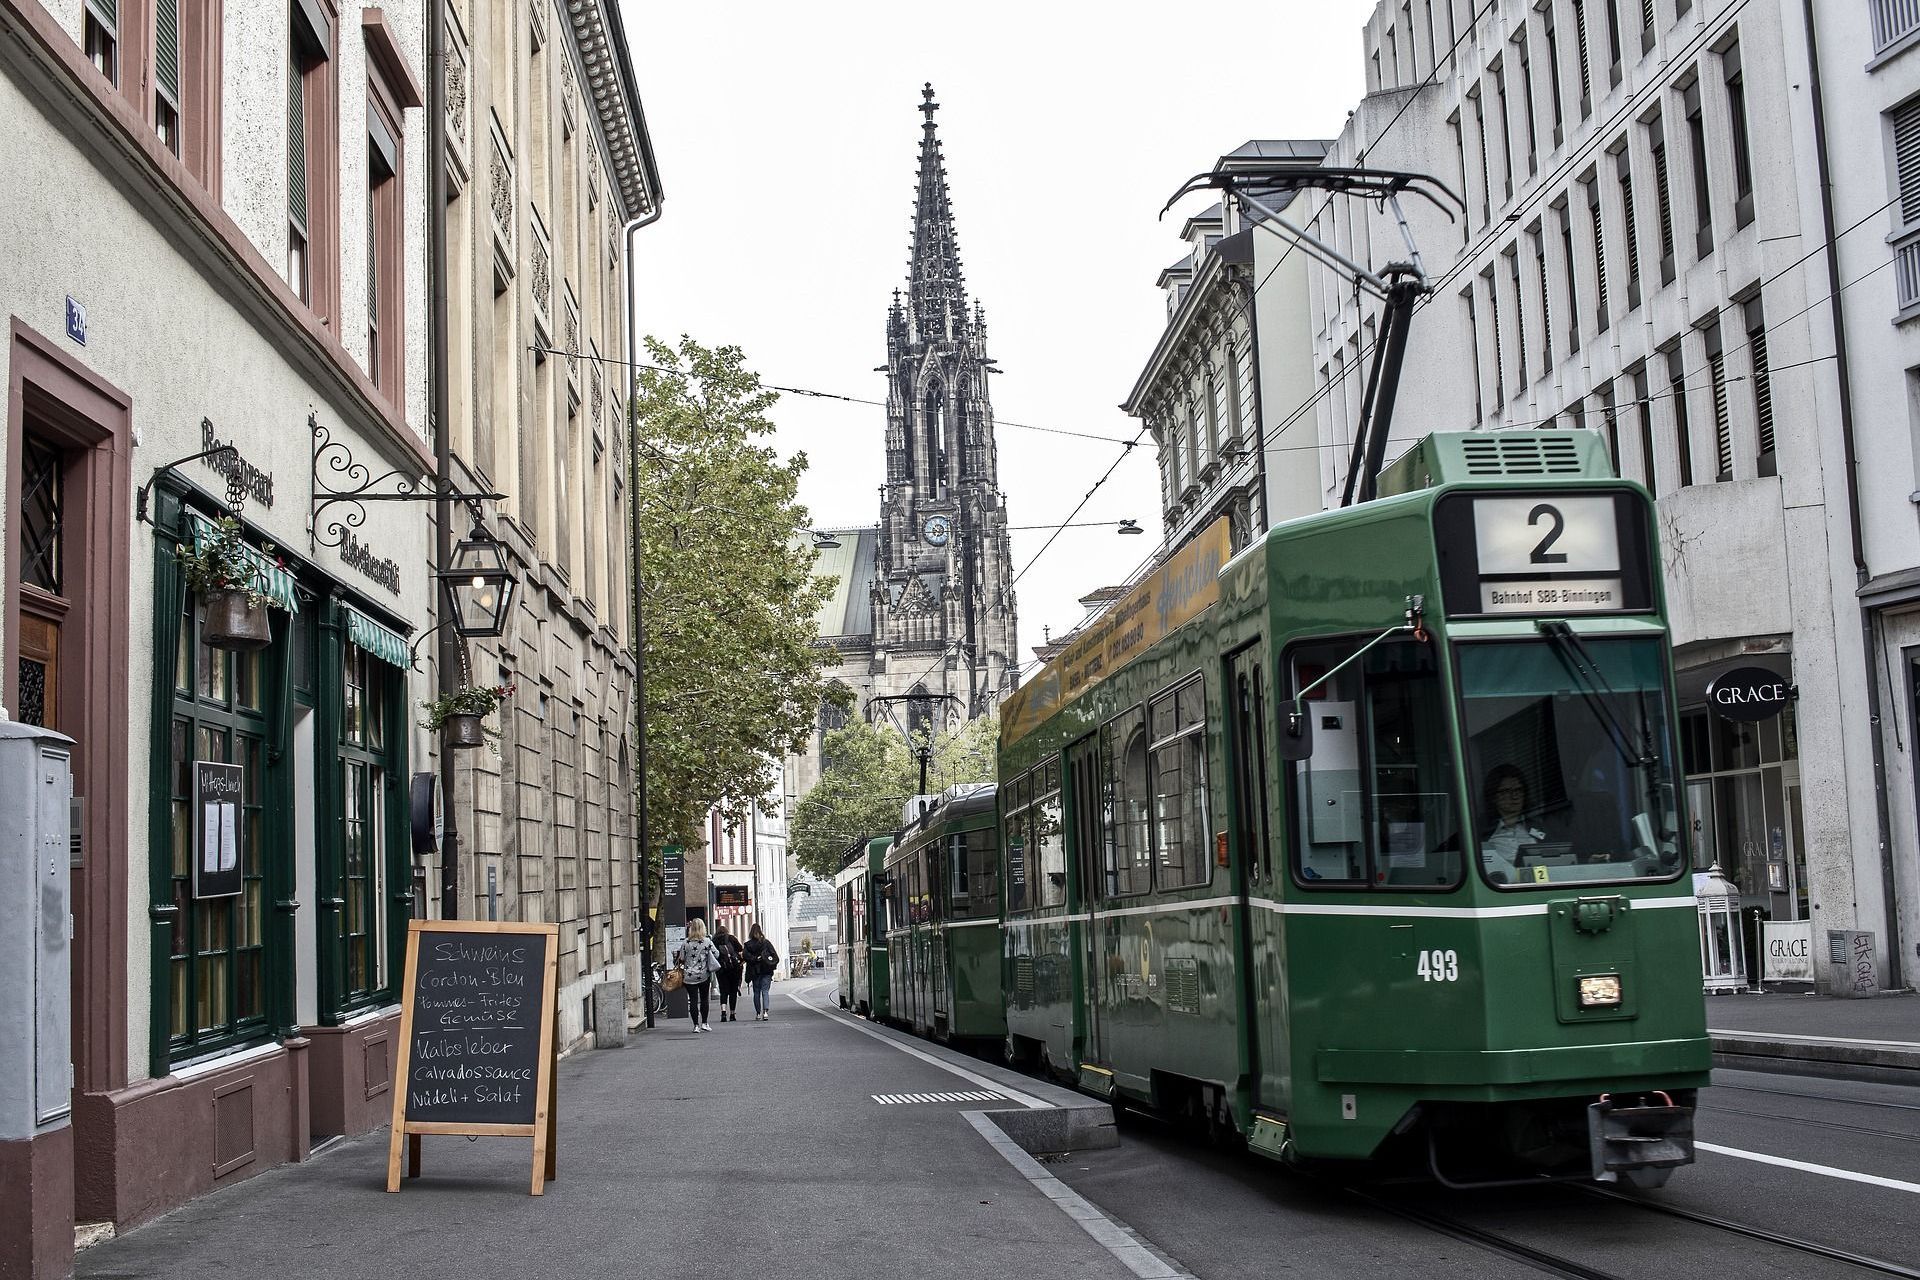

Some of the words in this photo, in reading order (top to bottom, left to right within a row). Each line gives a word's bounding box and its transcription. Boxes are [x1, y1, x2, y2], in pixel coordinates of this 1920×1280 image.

[1528, 503, 1568, 564] 2
[1491, 590, 1533, 605] Bahnhof
[1537, 589, 1612, 605] SBB-Binningen
[1716, 683, 1785, 705] GRACE
[1743, 841, 1767, 857] GRAC
[1537, 870, 1545, 880] 2
[435, 942, 526, 964] Schweins
[1770, 938, 1808, 958] GRACE
[1417, 949, 1459, 982] 493
[440, 1010, 517, 1025] Gemüse
[416, 1035, 513, 1060] Kalbsleber
[414, 1063, 531, 1081] Calvadossauce
[473, 1084, 522, 1104] Salat
